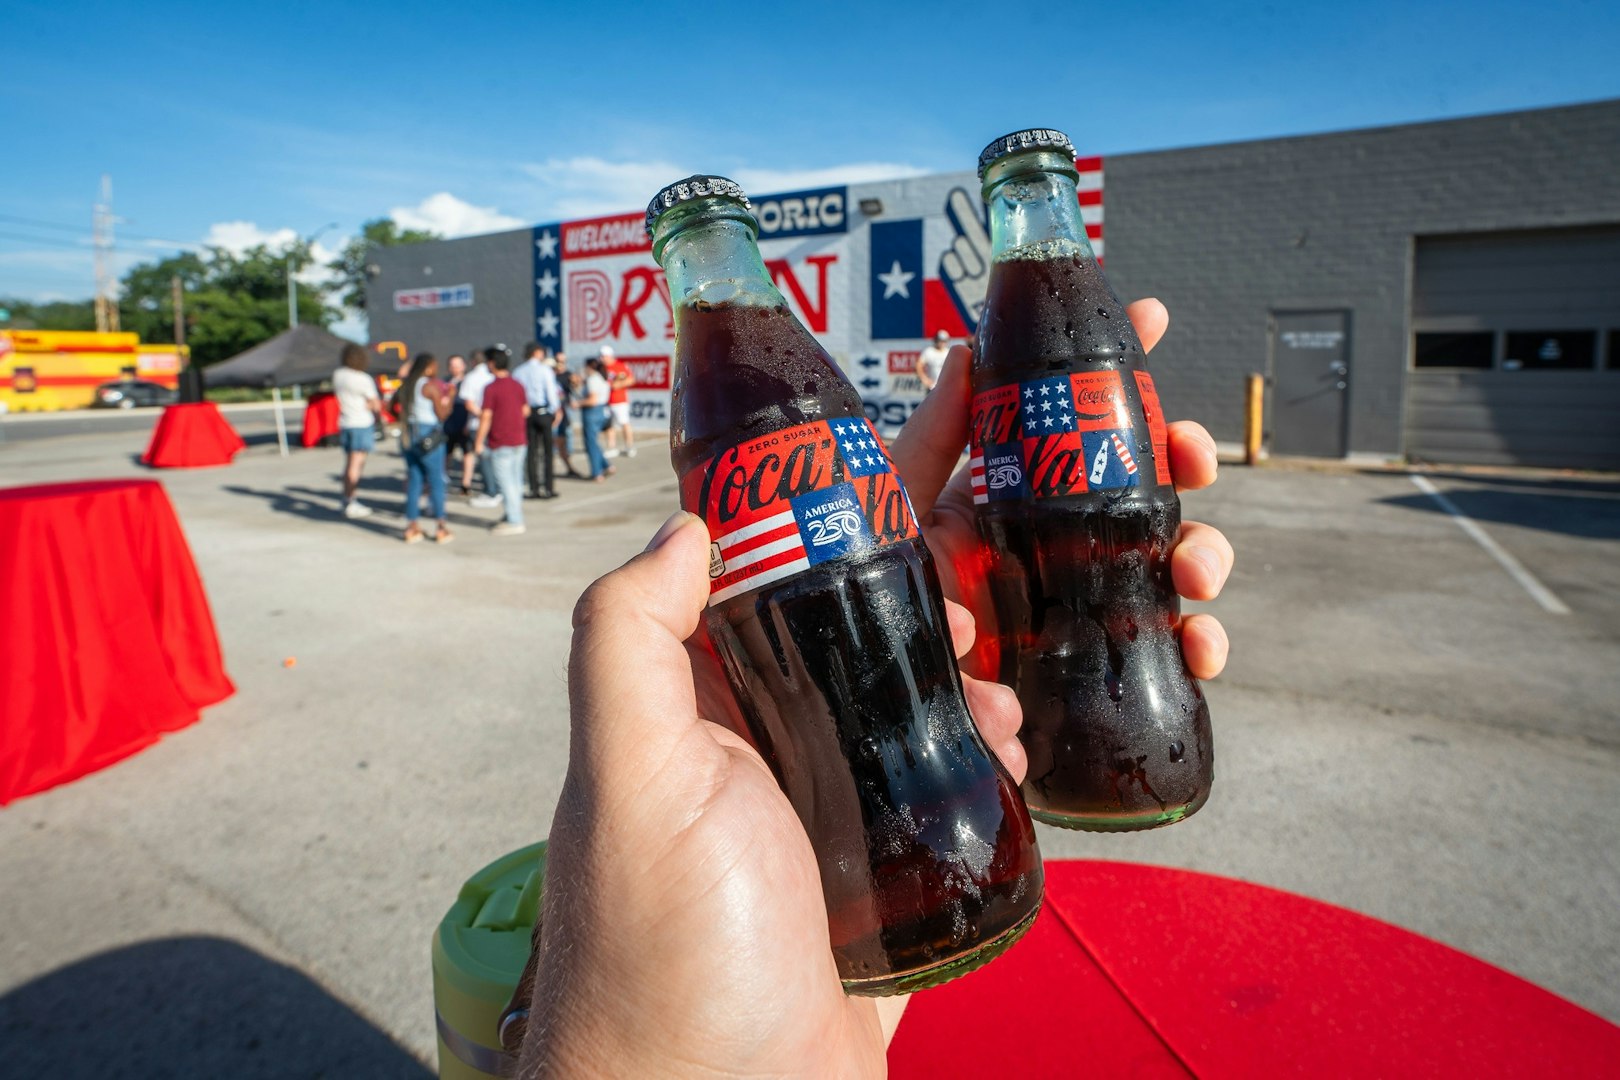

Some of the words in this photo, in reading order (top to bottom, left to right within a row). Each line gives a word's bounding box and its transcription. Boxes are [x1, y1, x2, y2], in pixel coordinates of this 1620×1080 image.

[565, 219, 648, 252] WELCOME
[748, 438, 779, 454] ZERO
[783, 426, 821, 442] SUGAR
[988, 455, 1019, 467] AMERICA
[988, 464, 1022, 489] 250
[804, 498, 853, 520] AMERICA
[807, 510, 861, 546] 250
